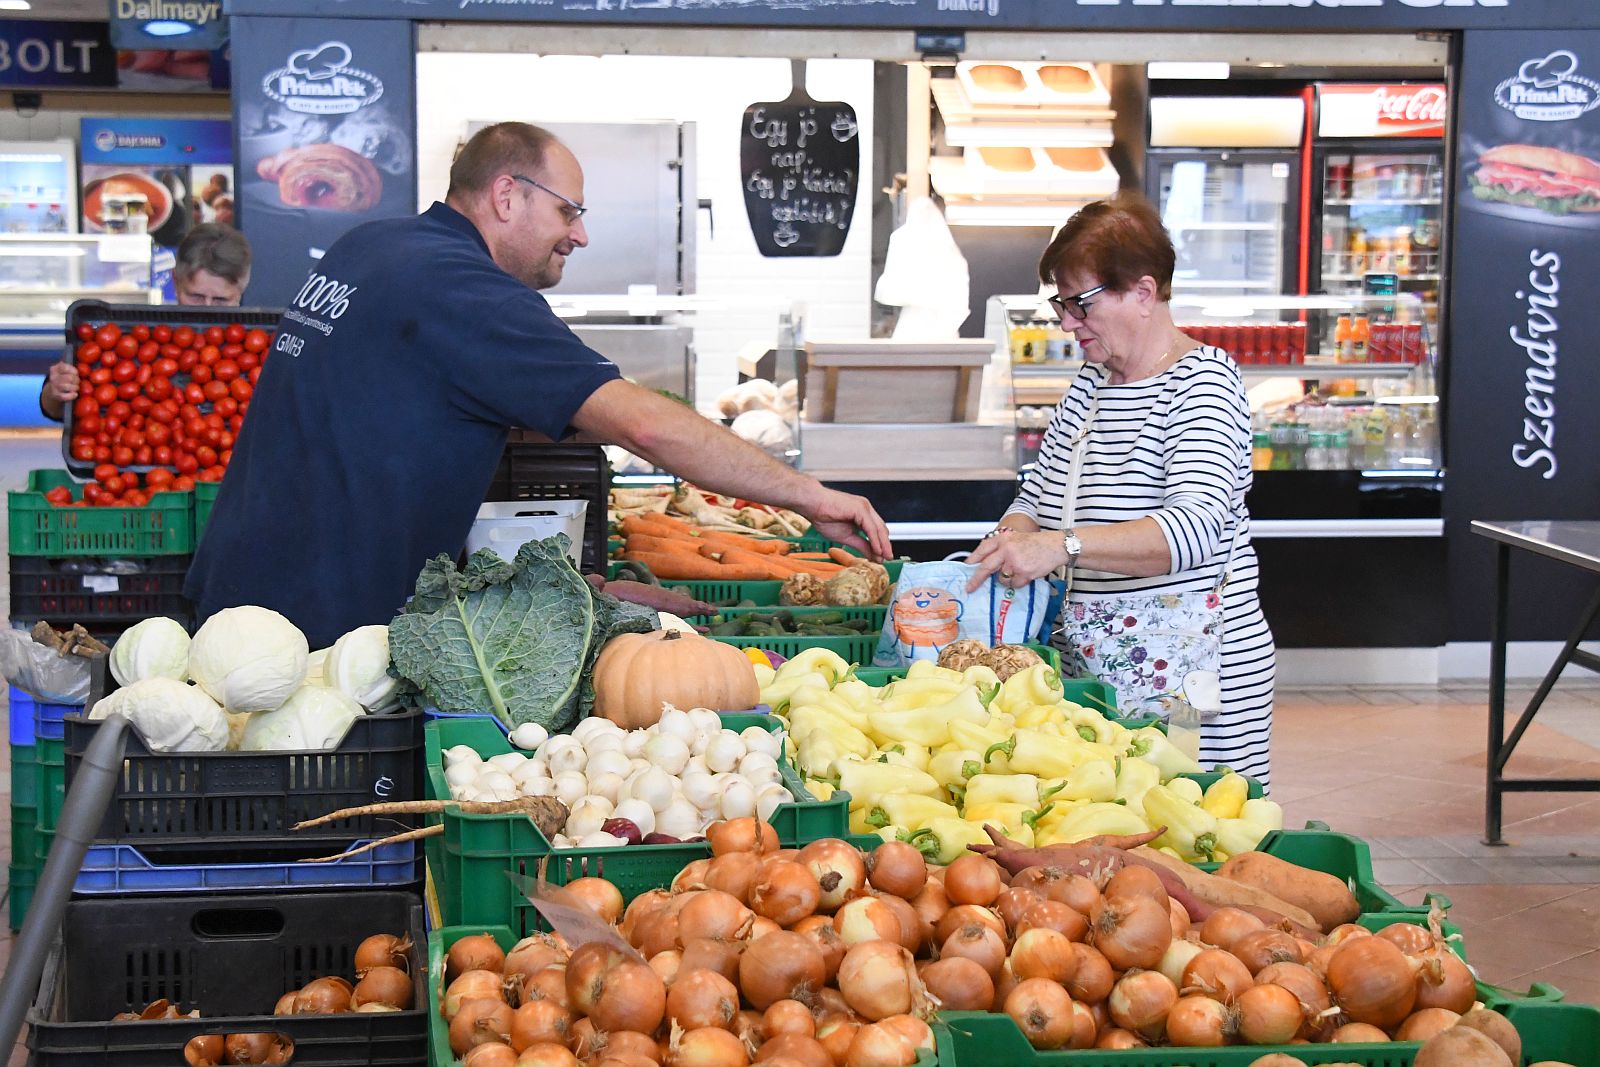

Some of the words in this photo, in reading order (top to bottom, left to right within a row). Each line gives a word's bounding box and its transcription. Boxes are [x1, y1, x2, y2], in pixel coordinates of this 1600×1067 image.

[117, 0, 220, 24] Dallmayr
[750, 107, 788, 147] Egy
[797, 106, 818, 148] jó
[746, 168, 775, 199] Egy
[292, 273, 357, 319] 100%
[1509, 248, 1561, 480] Szendvics
